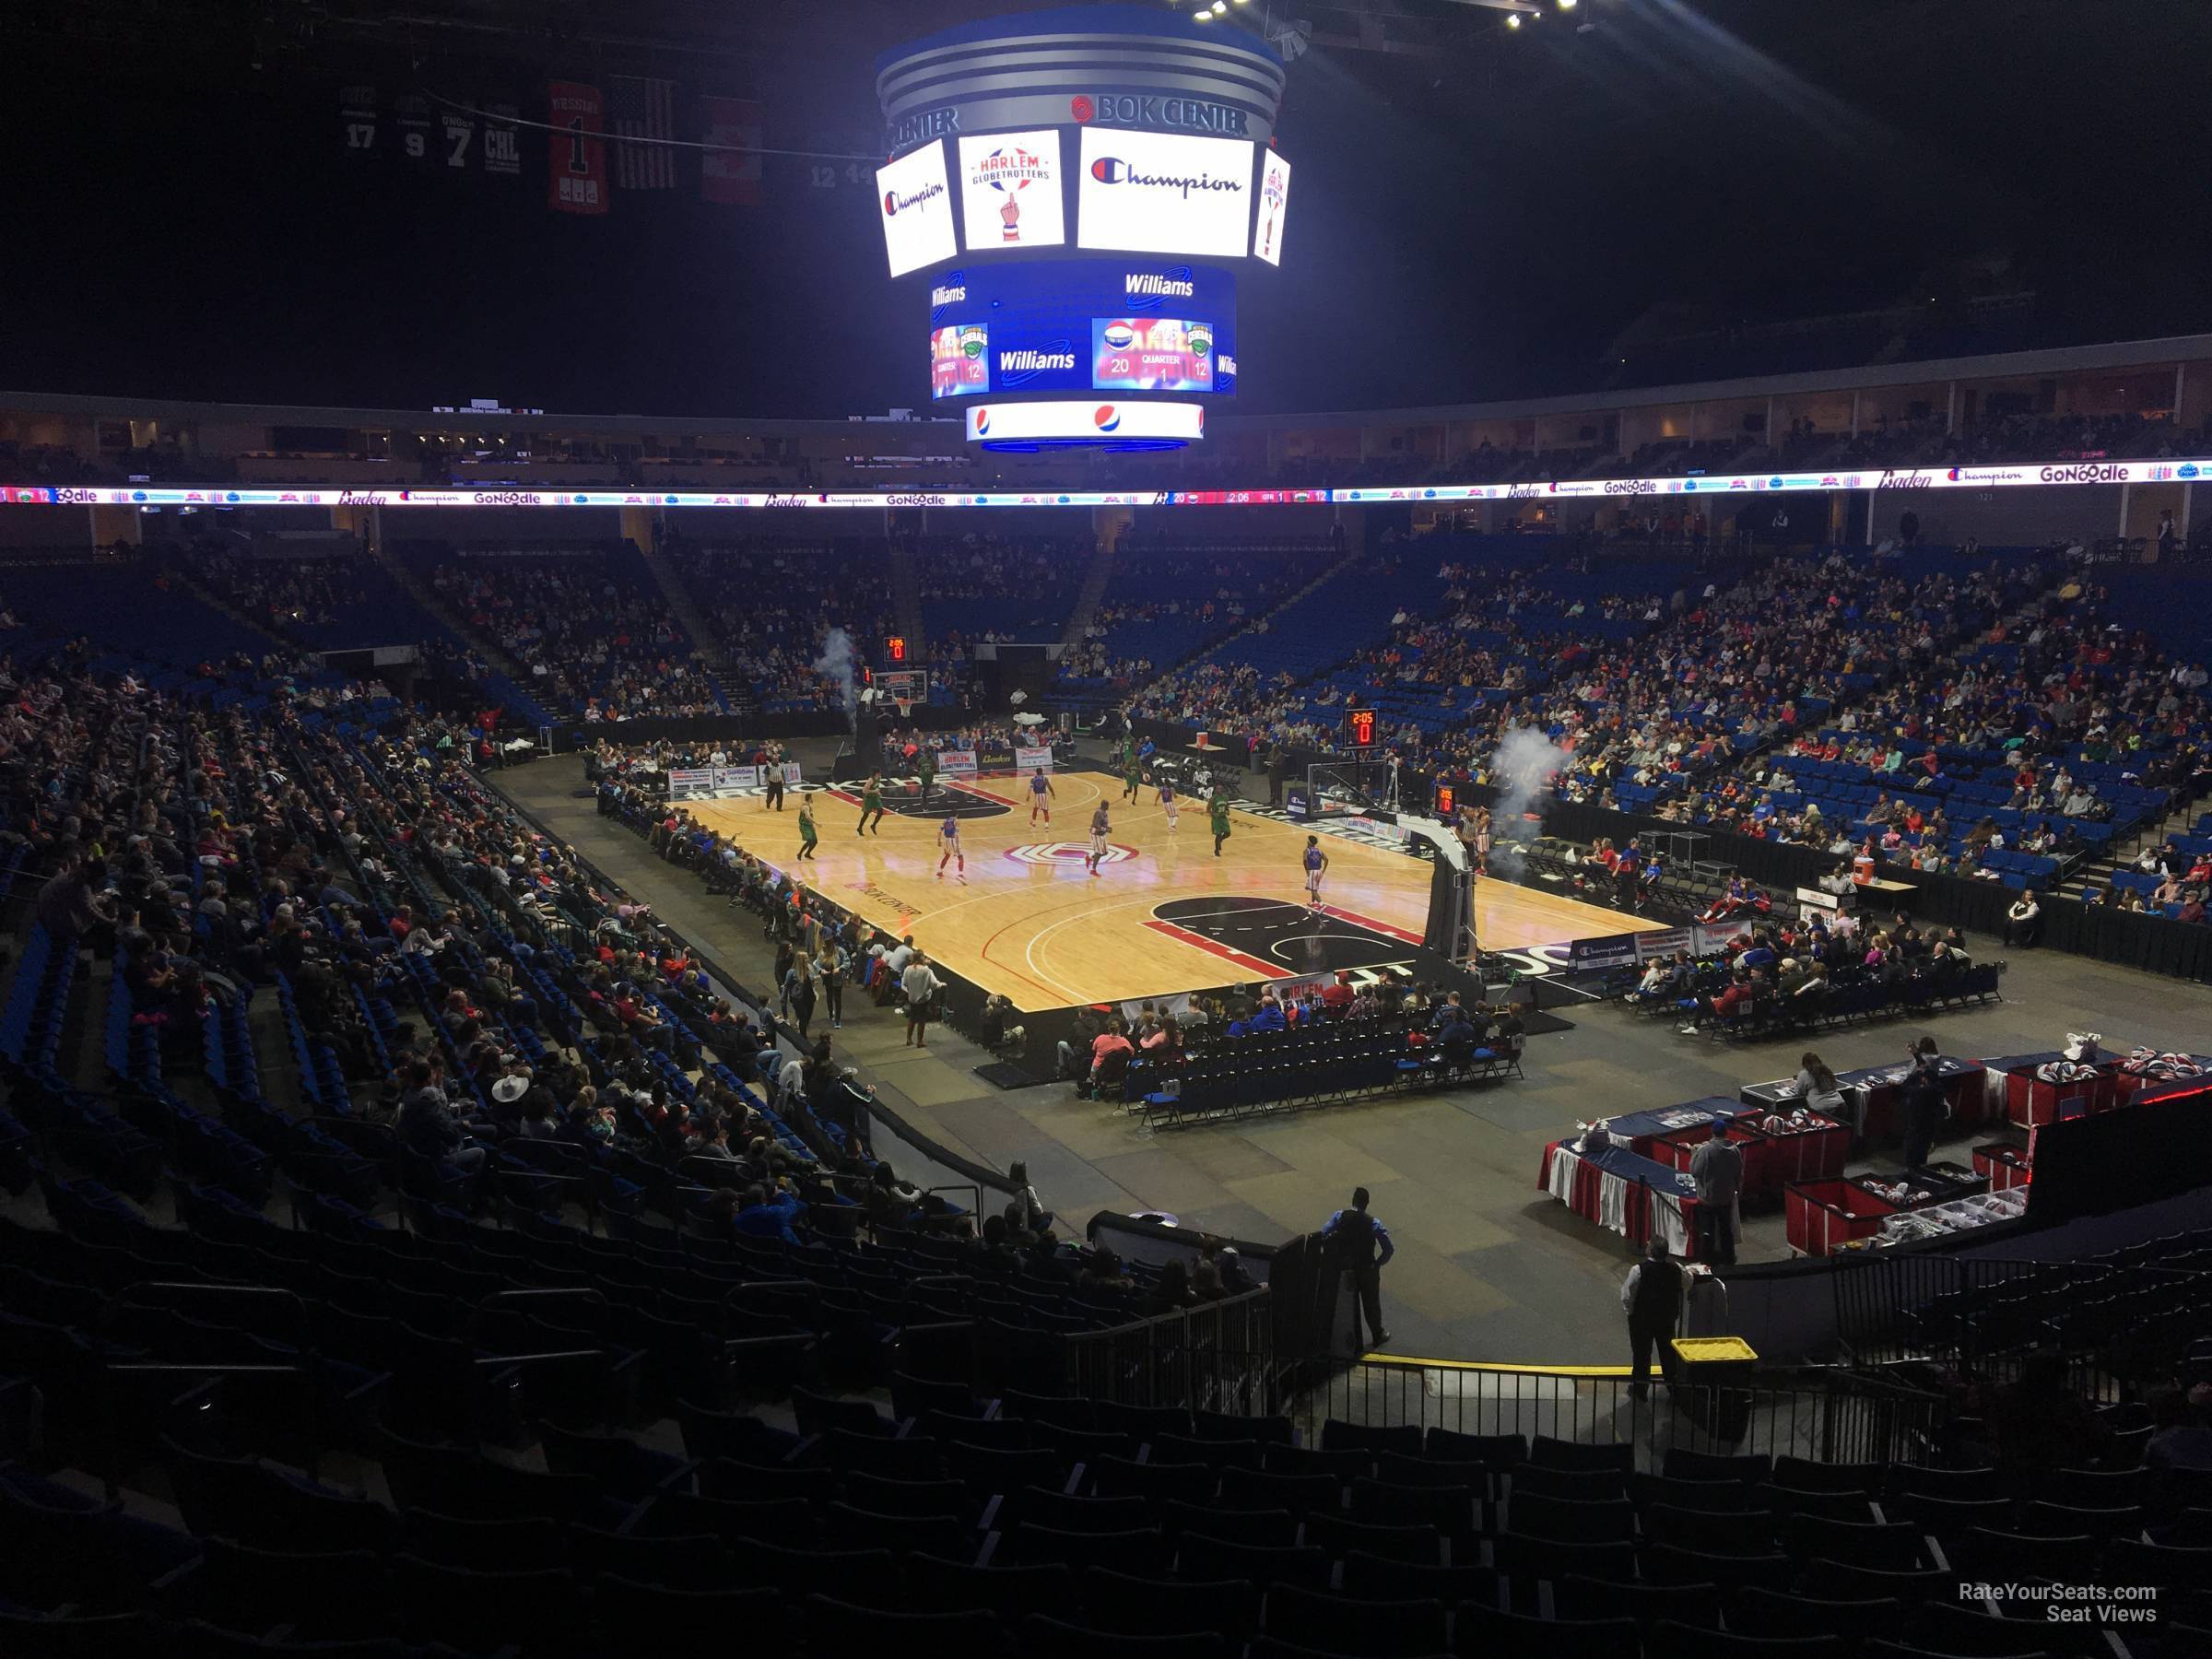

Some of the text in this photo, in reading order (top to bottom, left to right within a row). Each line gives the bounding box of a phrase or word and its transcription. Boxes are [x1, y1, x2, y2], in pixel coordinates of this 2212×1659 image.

[1098, 96, 1249, 135] BOK CENTER
[347, 124, 375, 147] 17
[406, 133, 425, 157] 9
[446, 127, 471, 167] 7
[485, 129, 520, 161] CHL
[569, 116, 588, 174] 1
[980, 156, 1039, 172] HARLEM
[972, 169, 1049, 184] GLOBETROTTERS
[1091, 158, 1242, 199] Champion
[885, 182, 944, 218] Champion
[1125, 274, 1194, 297] Williams
[932, 285, 966, 306] Williams
[1000, 350, 1075, 371] Williams
[1111, 358, 1129, 373] 20
[1142, 354, 1181, 365] QUARTER
[968, 364, 980, 378] 12
[1161, 369, 1167, 382] 1
[1194, 362, 1206, 376] 12
[1877, 469, 1932, 489] Baden
[1947, 464, 2128, 487] Champion GoNoodle
[1507, 484, 1540, 499] Baden
[1549, 480, 1594, 497] Champion
[1604, 478, 1656, 496] GoNoodle
[338, 490, 387, 505] Baden
[399, 490, 459, 506] Champion
[474, 491, 541, 506] GoNoodle
[764, 494, 806, 507] Baden
[818, 494, 874, 507] Champion
[887, 493, 946, 507] GoNoodle
[1174, 492, 1184, 502] 20
[1229, 493, 1249, 502] 2:06
[1315, 491, 1326, 502] 12
[894, 647, 901, 658] 0
[1353, 712, 1373, 724] 2:05
[1360, 724, 1371, 743] 0
[1445, 800, 1450, 811] 0
[1579, 944, 1629, 958] Champion
